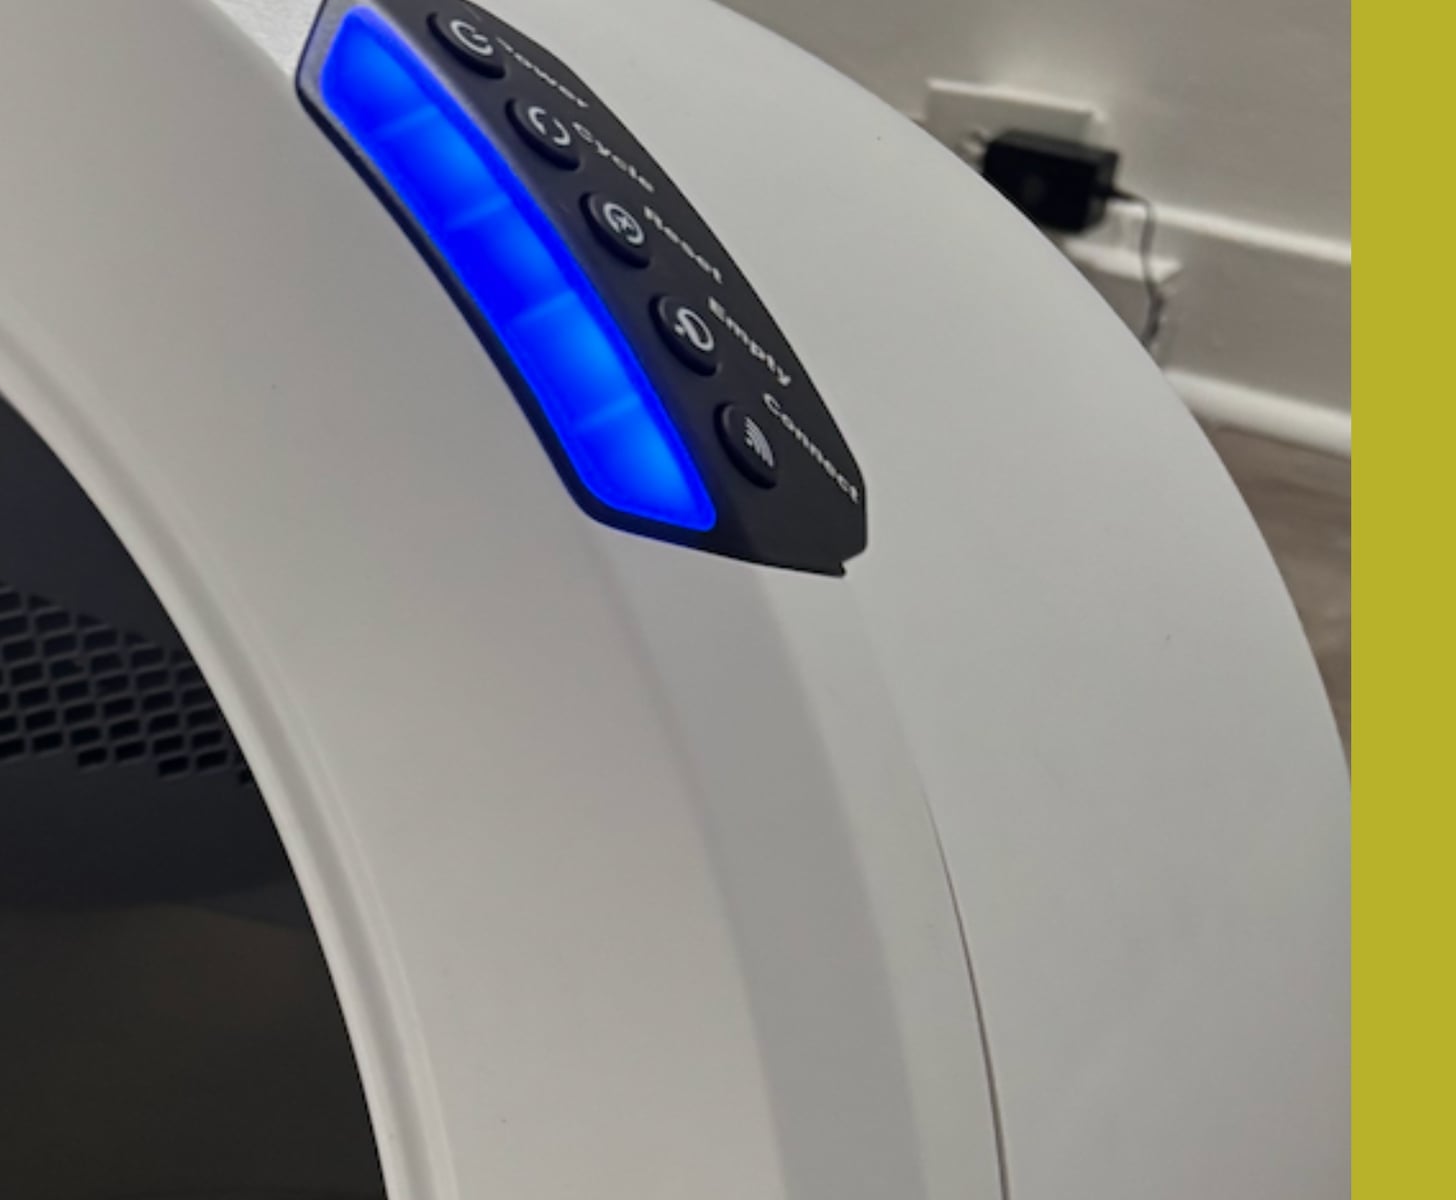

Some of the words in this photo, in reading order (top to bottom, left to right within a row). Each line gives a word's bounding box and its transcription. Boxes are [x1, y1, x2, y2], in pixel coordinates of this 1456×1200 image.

[572, 121, 655, 193] Cycle
[644, 205, 723, 285] Reset
[707, 296, 792, 387] Empty
[763, 392, 859, 504] Connect
